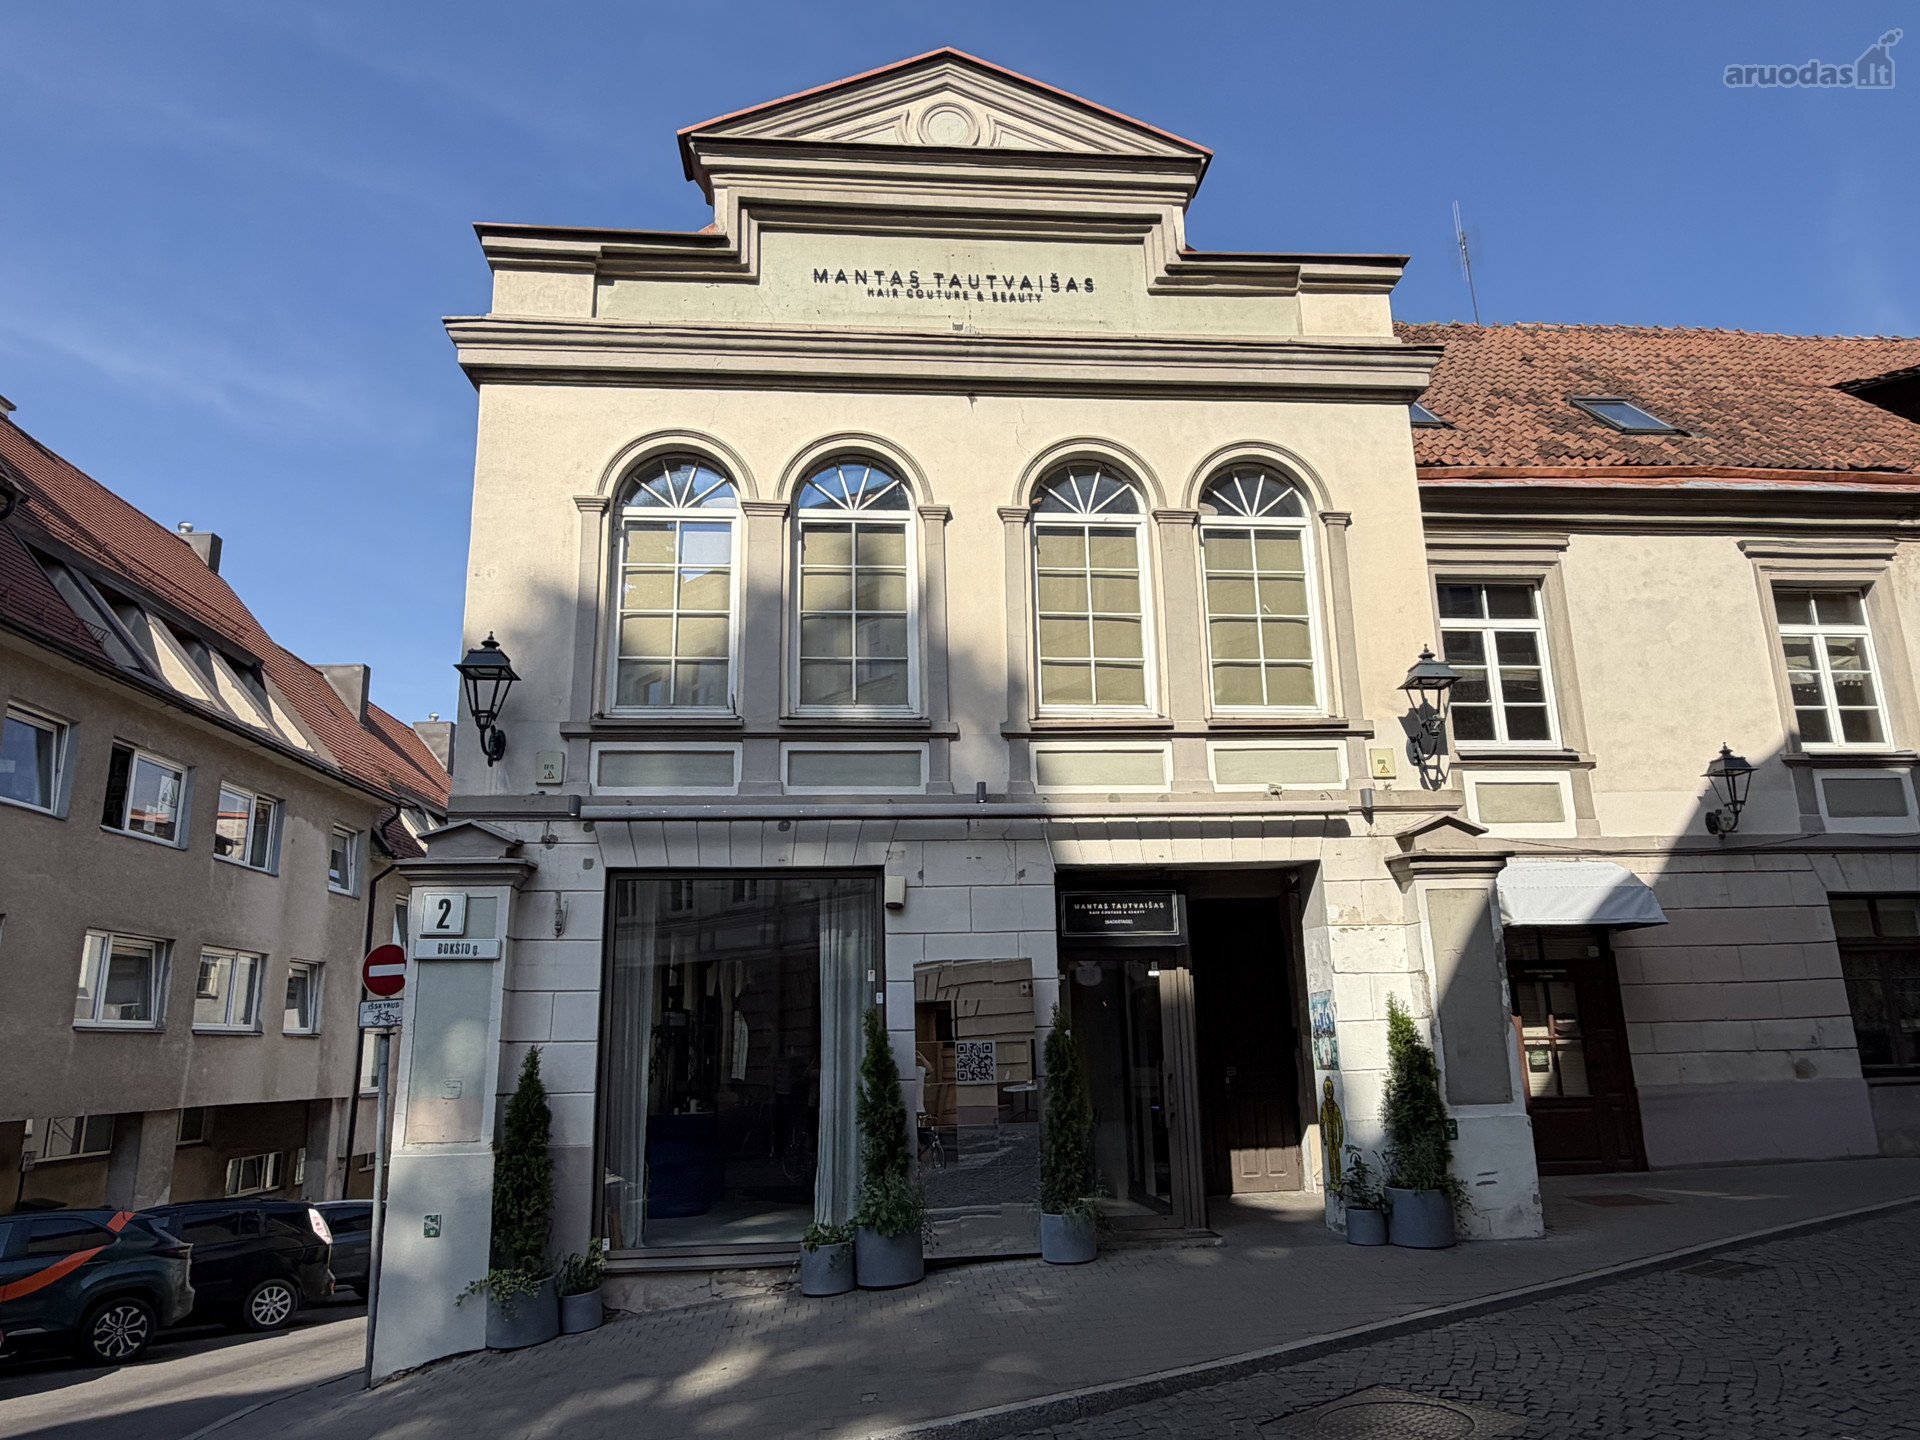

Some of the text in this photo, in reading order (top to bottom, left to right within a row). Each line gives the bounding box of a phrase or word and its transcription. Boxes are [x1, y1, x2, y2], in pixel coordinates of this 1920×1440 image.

[813, 268, 1096, 293] MANTAS TAUTVAIŠAS
[867, 287, 1042, 303] HAIR COUTURE & BEAUTY
[436, 898, 452, 929] 2
[1073, 901, 1165, 910] MANTAS TAUTVAIŠAS
[437, 940, 480, 956] BOKŠTO g.
[368, 1001, 400, 1010] IŠSKYRUS
